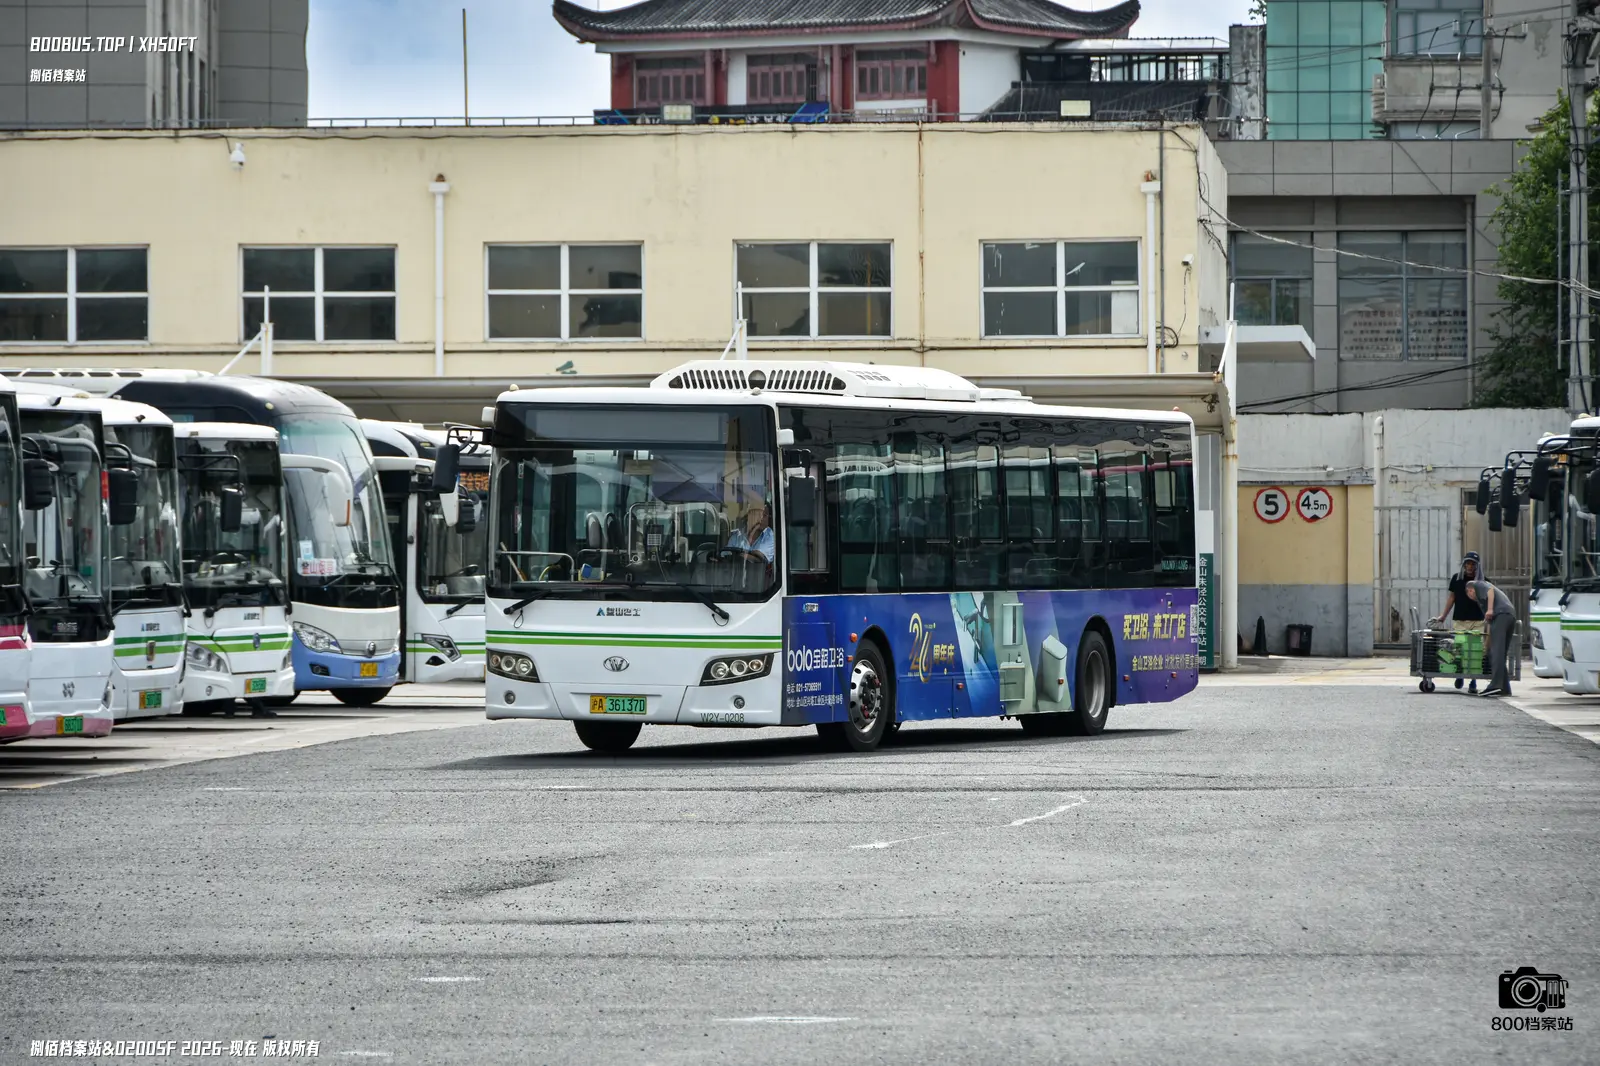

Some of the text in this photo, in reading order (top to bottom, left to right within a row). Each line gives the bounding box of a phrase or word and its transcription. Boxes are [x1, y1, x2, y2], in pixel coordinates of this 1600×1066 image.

[1264, 494, 1279, 516] 5
[1301, 495, 1328, 511] 4.5m
[787, 629, 813, 672] bolo
[608, 698, 645, 712] 36137D
[701, 713, 745, 723] W2Y-0208
